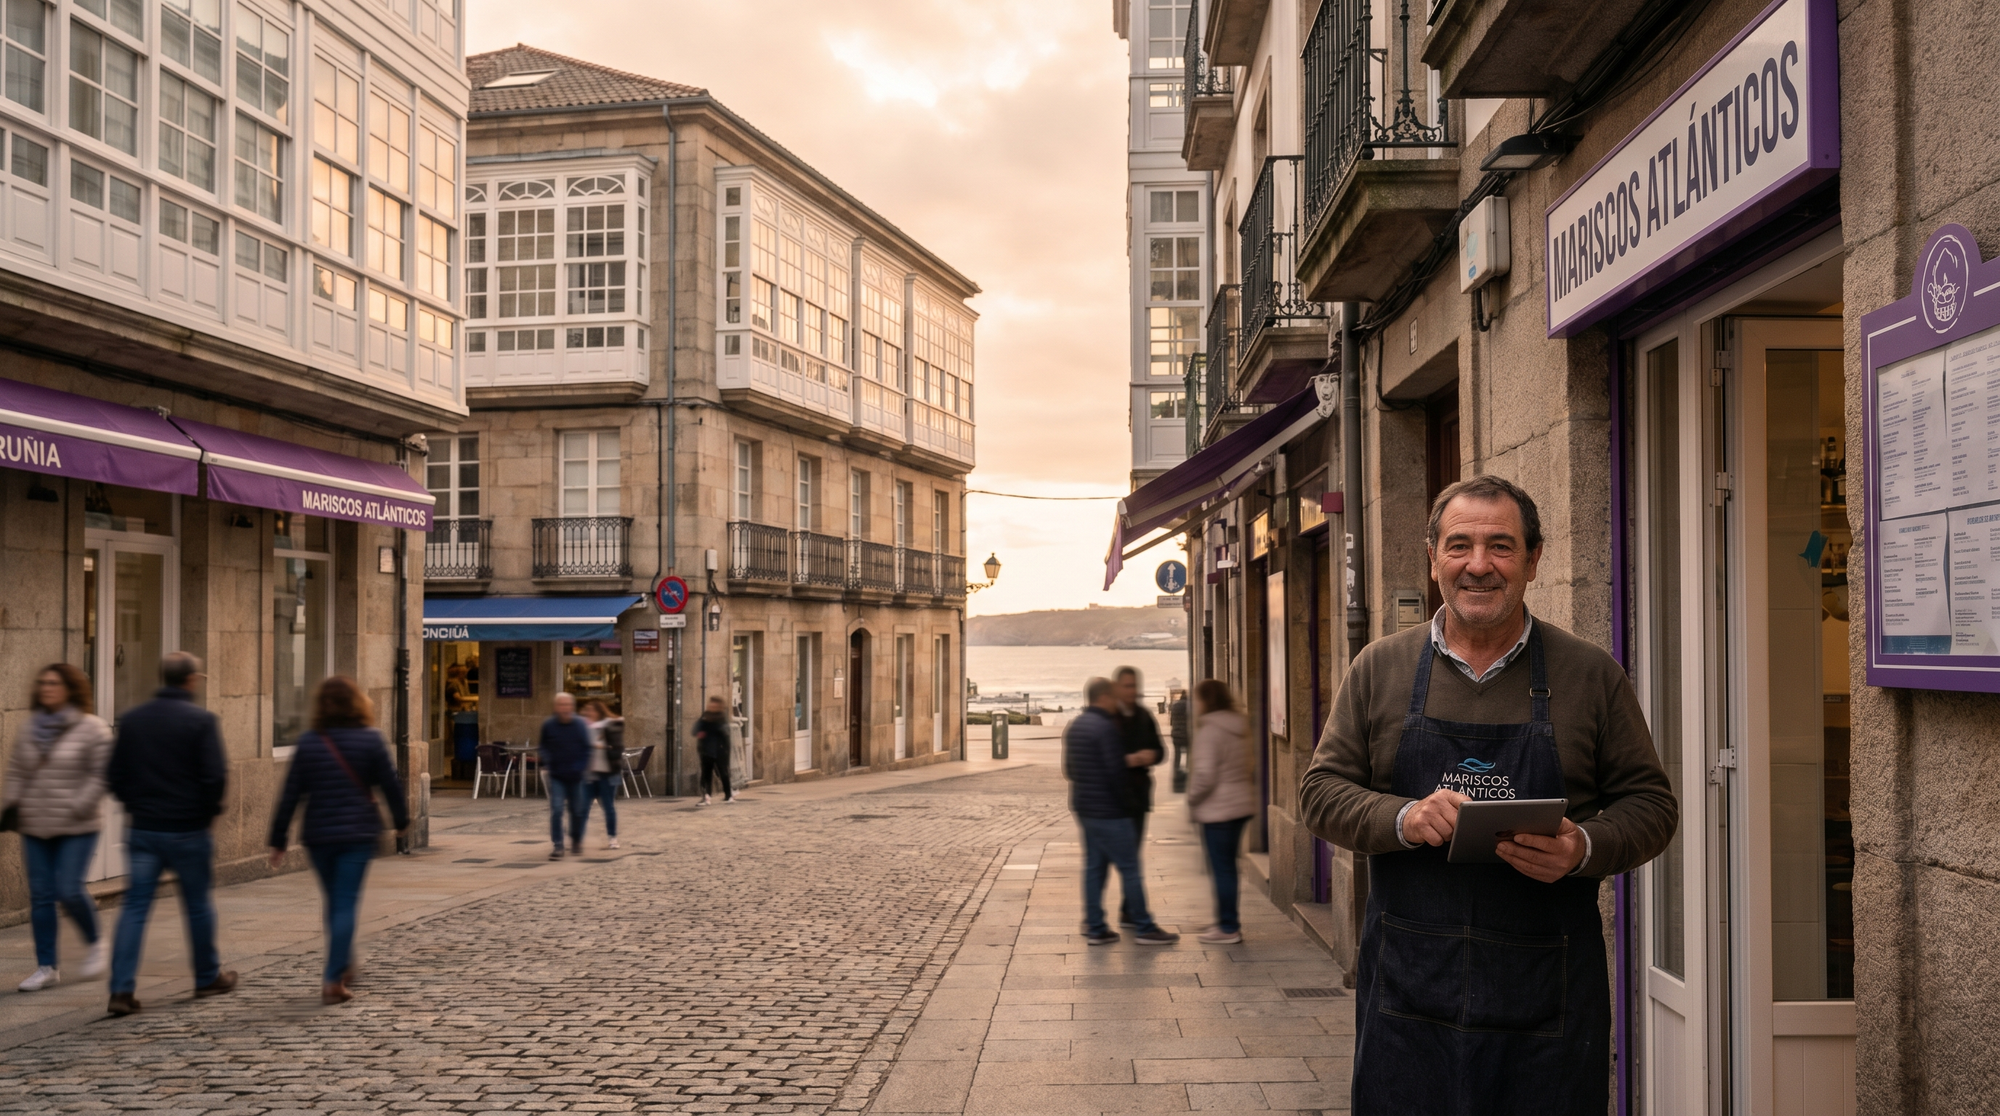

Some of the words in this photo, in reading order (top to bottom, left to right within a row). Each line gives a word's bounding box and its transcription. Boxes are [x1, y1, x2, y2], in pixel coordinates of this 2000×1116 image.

[1552, 170, 1641, 303] MARISCOS
[1646, 40, 1799, 239] ATLÁNTICOS
[302, 490, 362, 517] MARISCOS
[364, 500, 427, 527] ATLÁNTICOS
[1441, 771, 1510, 787] MARISCOS
